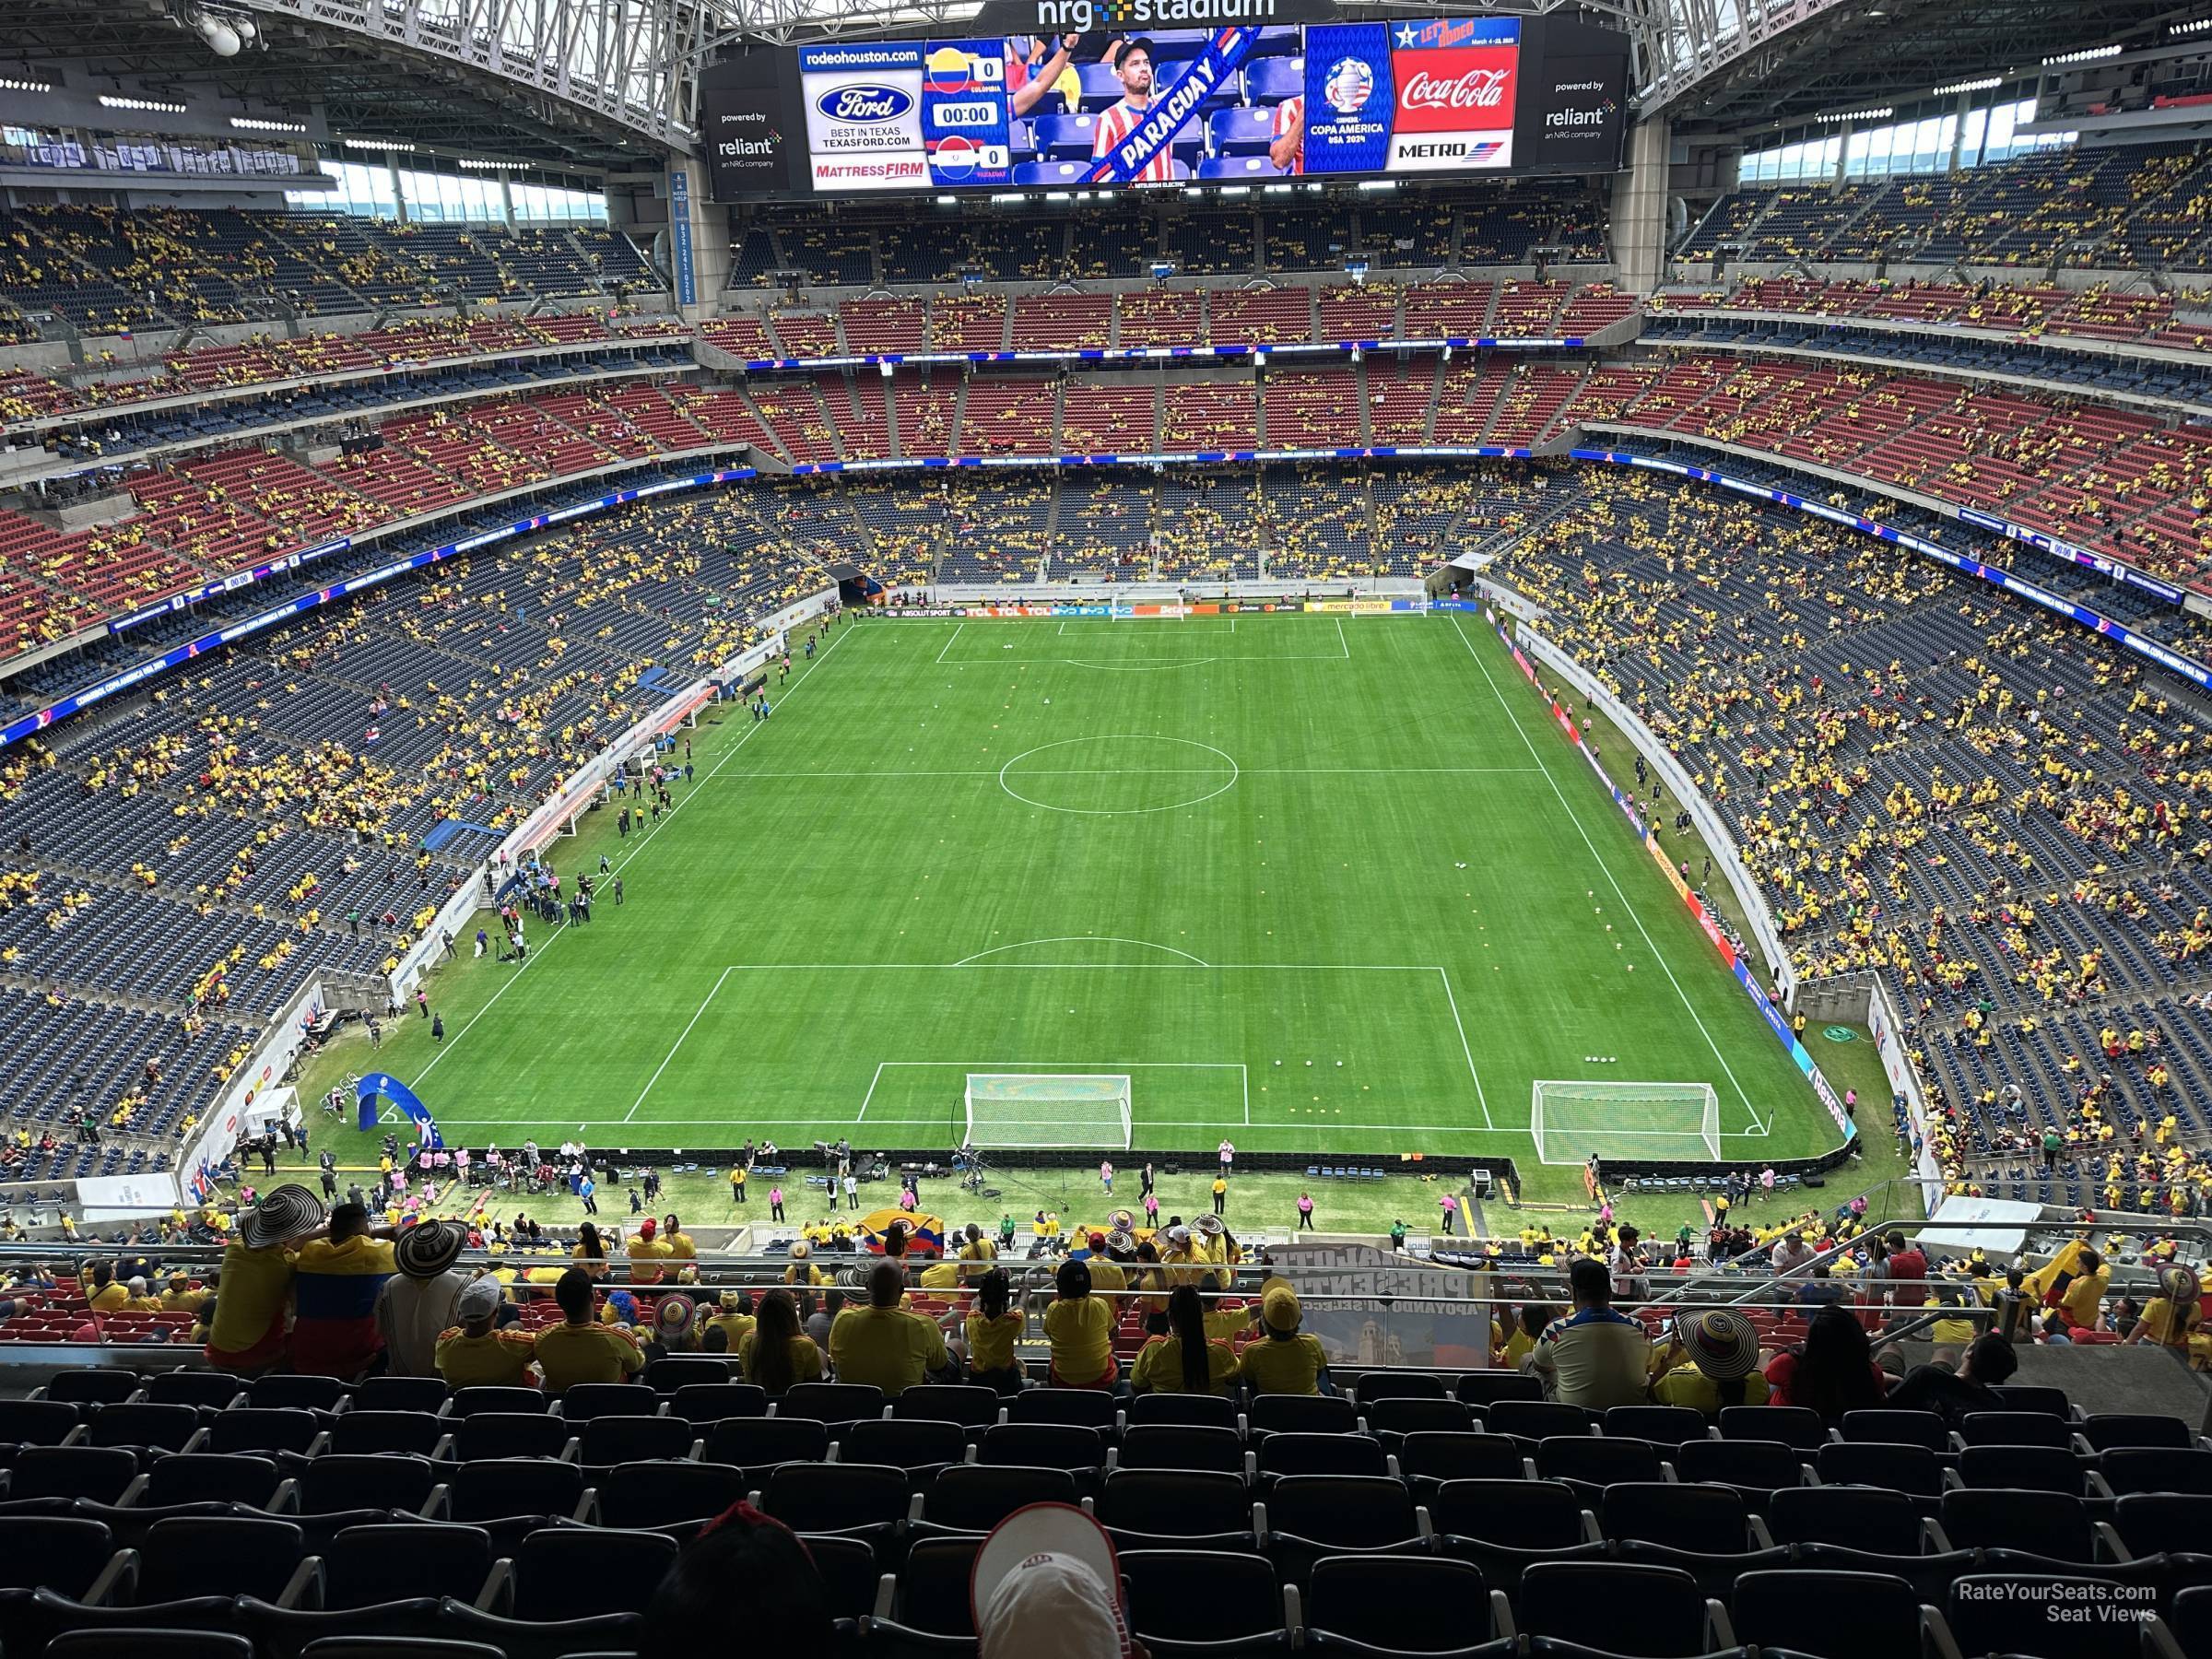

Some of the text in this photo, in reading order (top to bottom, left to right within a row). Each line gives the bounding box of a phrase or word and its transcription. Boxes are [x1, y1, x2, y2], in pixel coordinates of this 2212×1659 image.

[1038, 0, 1275, 32] nrg stadium
[806, 50, 918, 65] rodeohouston.com
[984, 63, 994, 76] 0
[1402, 69, 1511, 110] Coca-Cola
[1555, 81, 1604, 92] powered by
[836, 89, 895, 117] Ford
[721, 112, 766, 124] powered by
[943, 108, 989, 123] 00:00
[1120, 57, 1217, 169] PARAGUAY
[1546, 108, 1604, 126] reliant
[830, 127, 900, 137] BEST IN TEXAS
[1311, 125, 1336, 135] COPA
[1571, 131, 1602, 139] company
[719, 138, 773, 156] reliant
[823, 137, 911, 148] TEXASFORD.COM
[989, 150, 998, 164] 0
[1398, 143, 1466, 159] METRO
[746, 160, 773, 169] company
[901, 608, 951, 617] ABSOLUT SPORT
[969, 607, 992, 616] TCL
[998, 607, 1020, 616] TCL
[1328, 602, 1384, 610] mercado libre
[1814, 1069, 1846, 1134] Rexona
